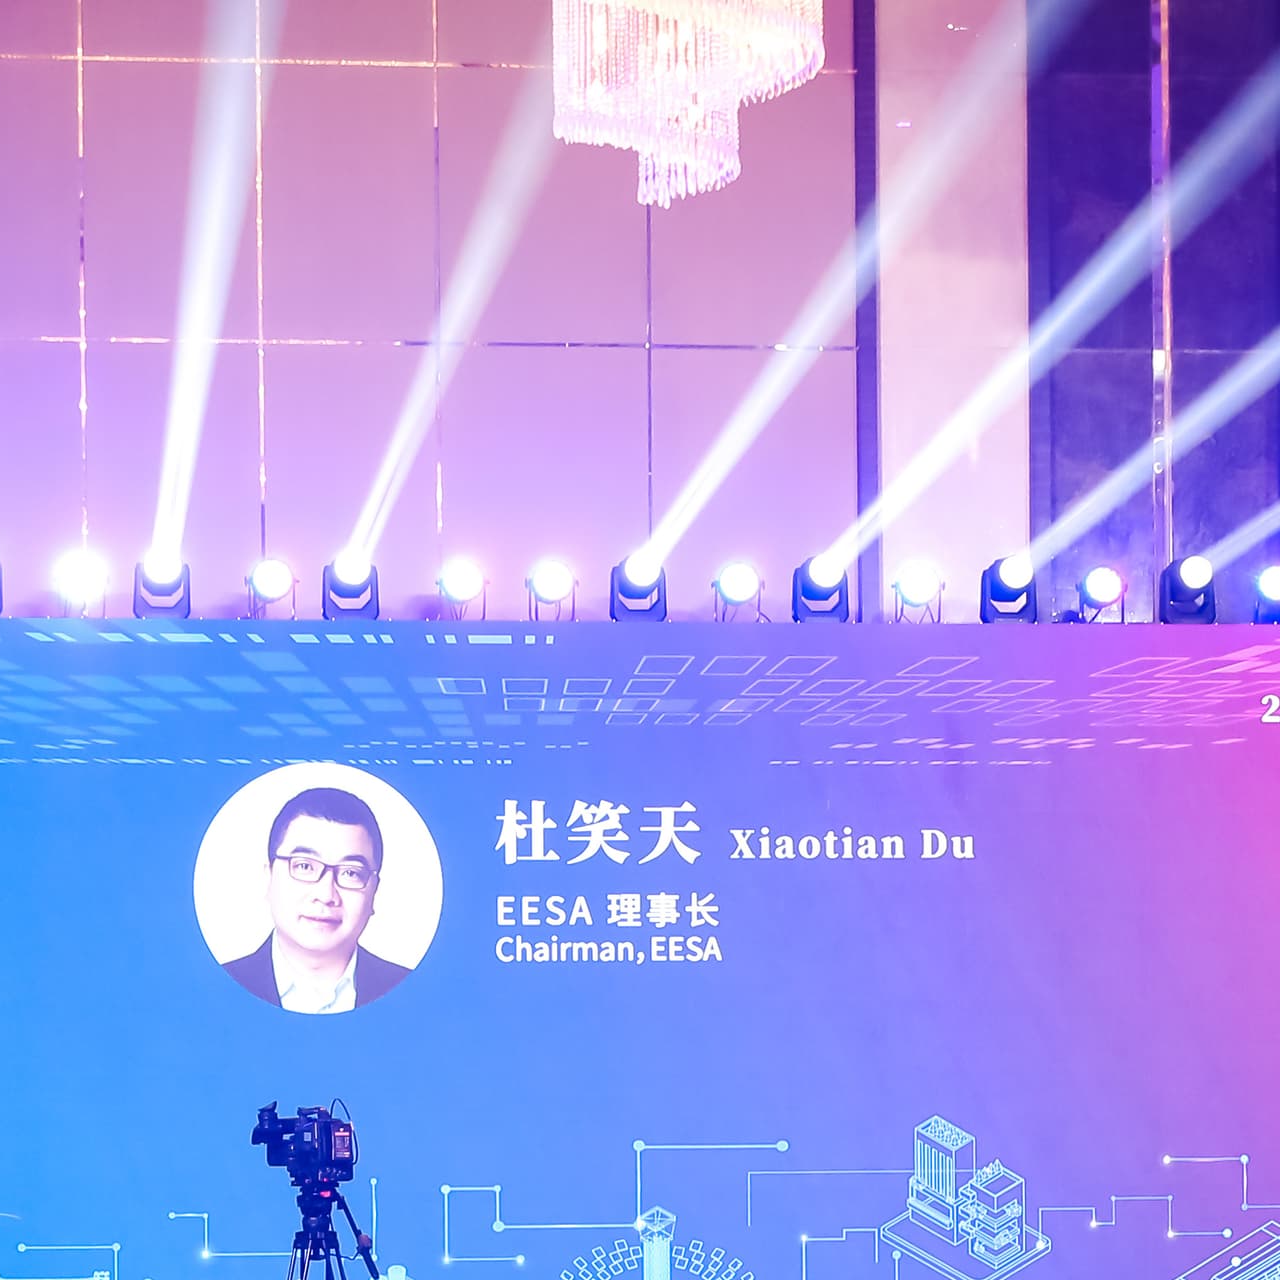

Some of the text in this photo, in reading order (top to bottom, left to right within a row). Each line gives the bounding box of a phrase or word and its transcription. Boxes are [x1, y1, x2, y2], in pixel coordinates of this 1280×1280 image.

[495, 799, 702, 865] 杜笑天
[729, 827, 976, 859] Xiaotian Du
[498, 891, 719, 928] EESA 理事长
